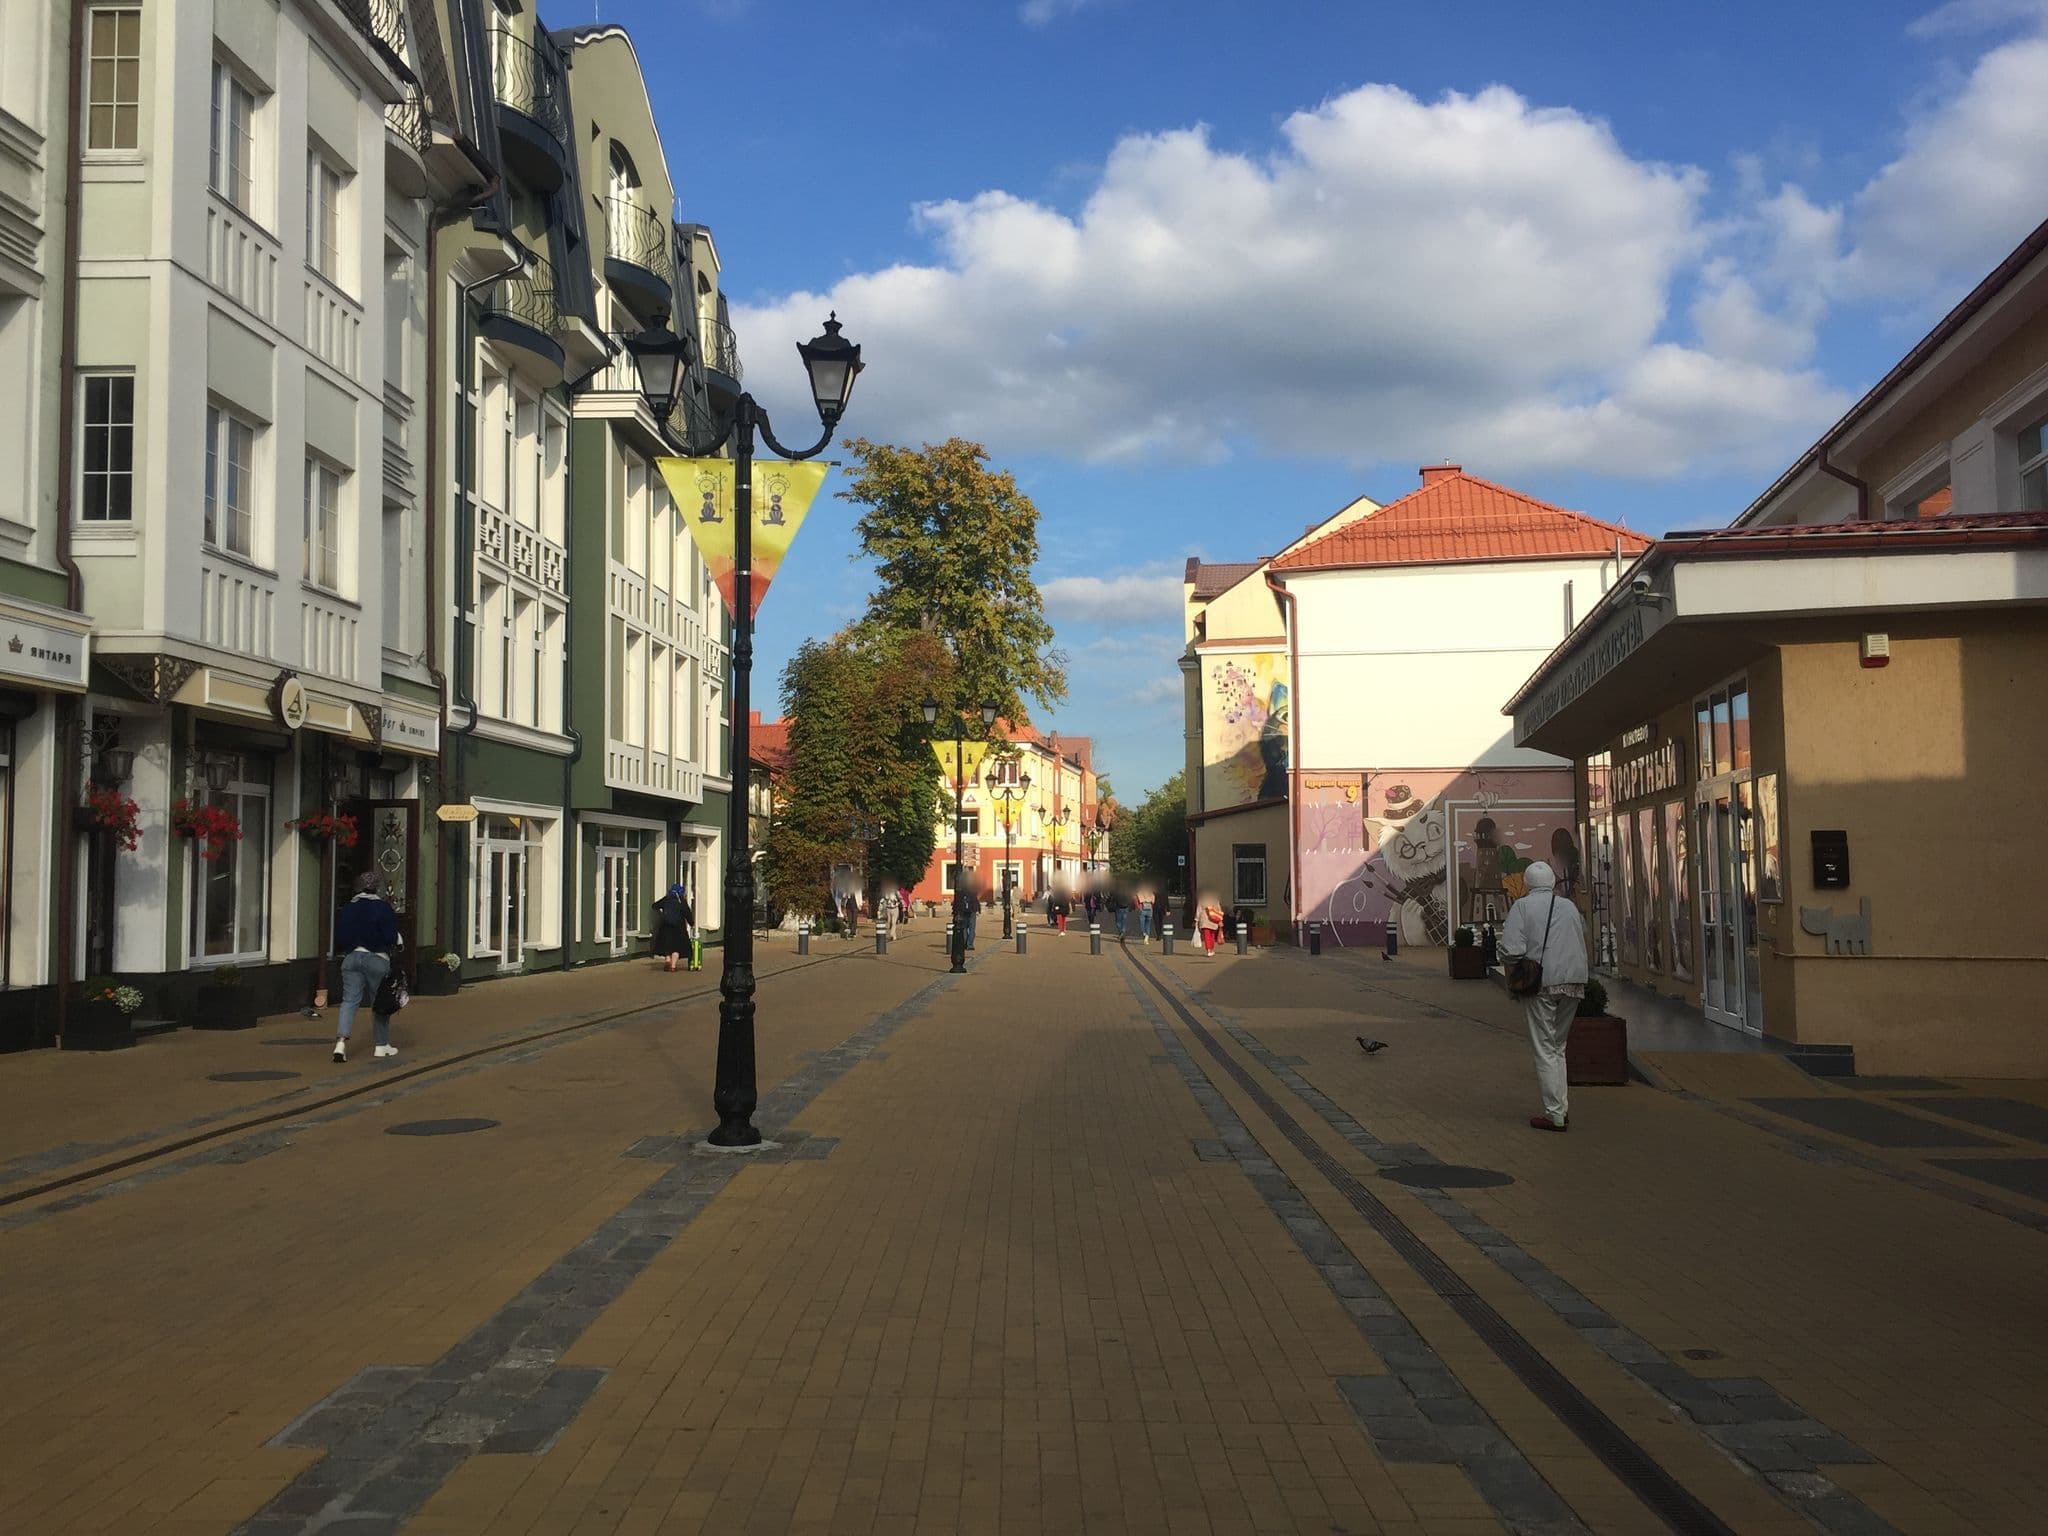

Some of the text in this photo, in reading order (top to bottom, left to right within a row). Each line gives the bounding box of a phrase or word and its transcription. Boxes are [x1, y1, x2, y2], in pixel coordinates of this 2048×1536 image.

[30, 646, 72, 664] ЯНТАРЯ
[382, 713, 396, 730] ber
[1346, 785, 1358, 803] 9
